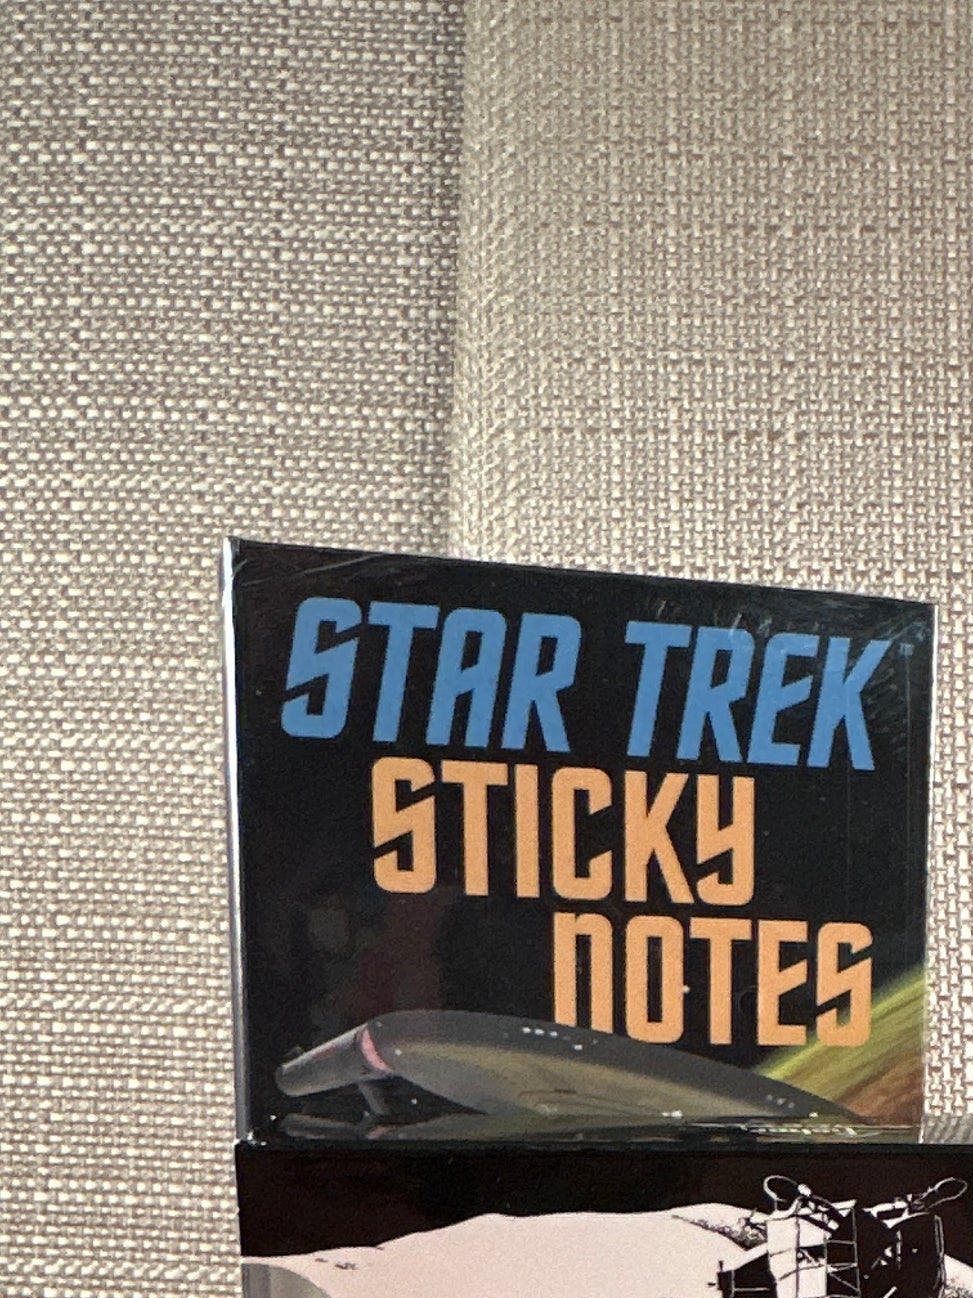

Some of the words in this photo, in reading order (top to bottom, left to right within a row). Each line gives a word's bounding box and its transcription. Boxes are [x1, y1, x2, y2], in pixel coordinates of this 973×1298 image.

[281, 597, 582, 753] STAR
[371, 757, 755, 906] STICKY
[553, 911, 873, 1047] NOTES
